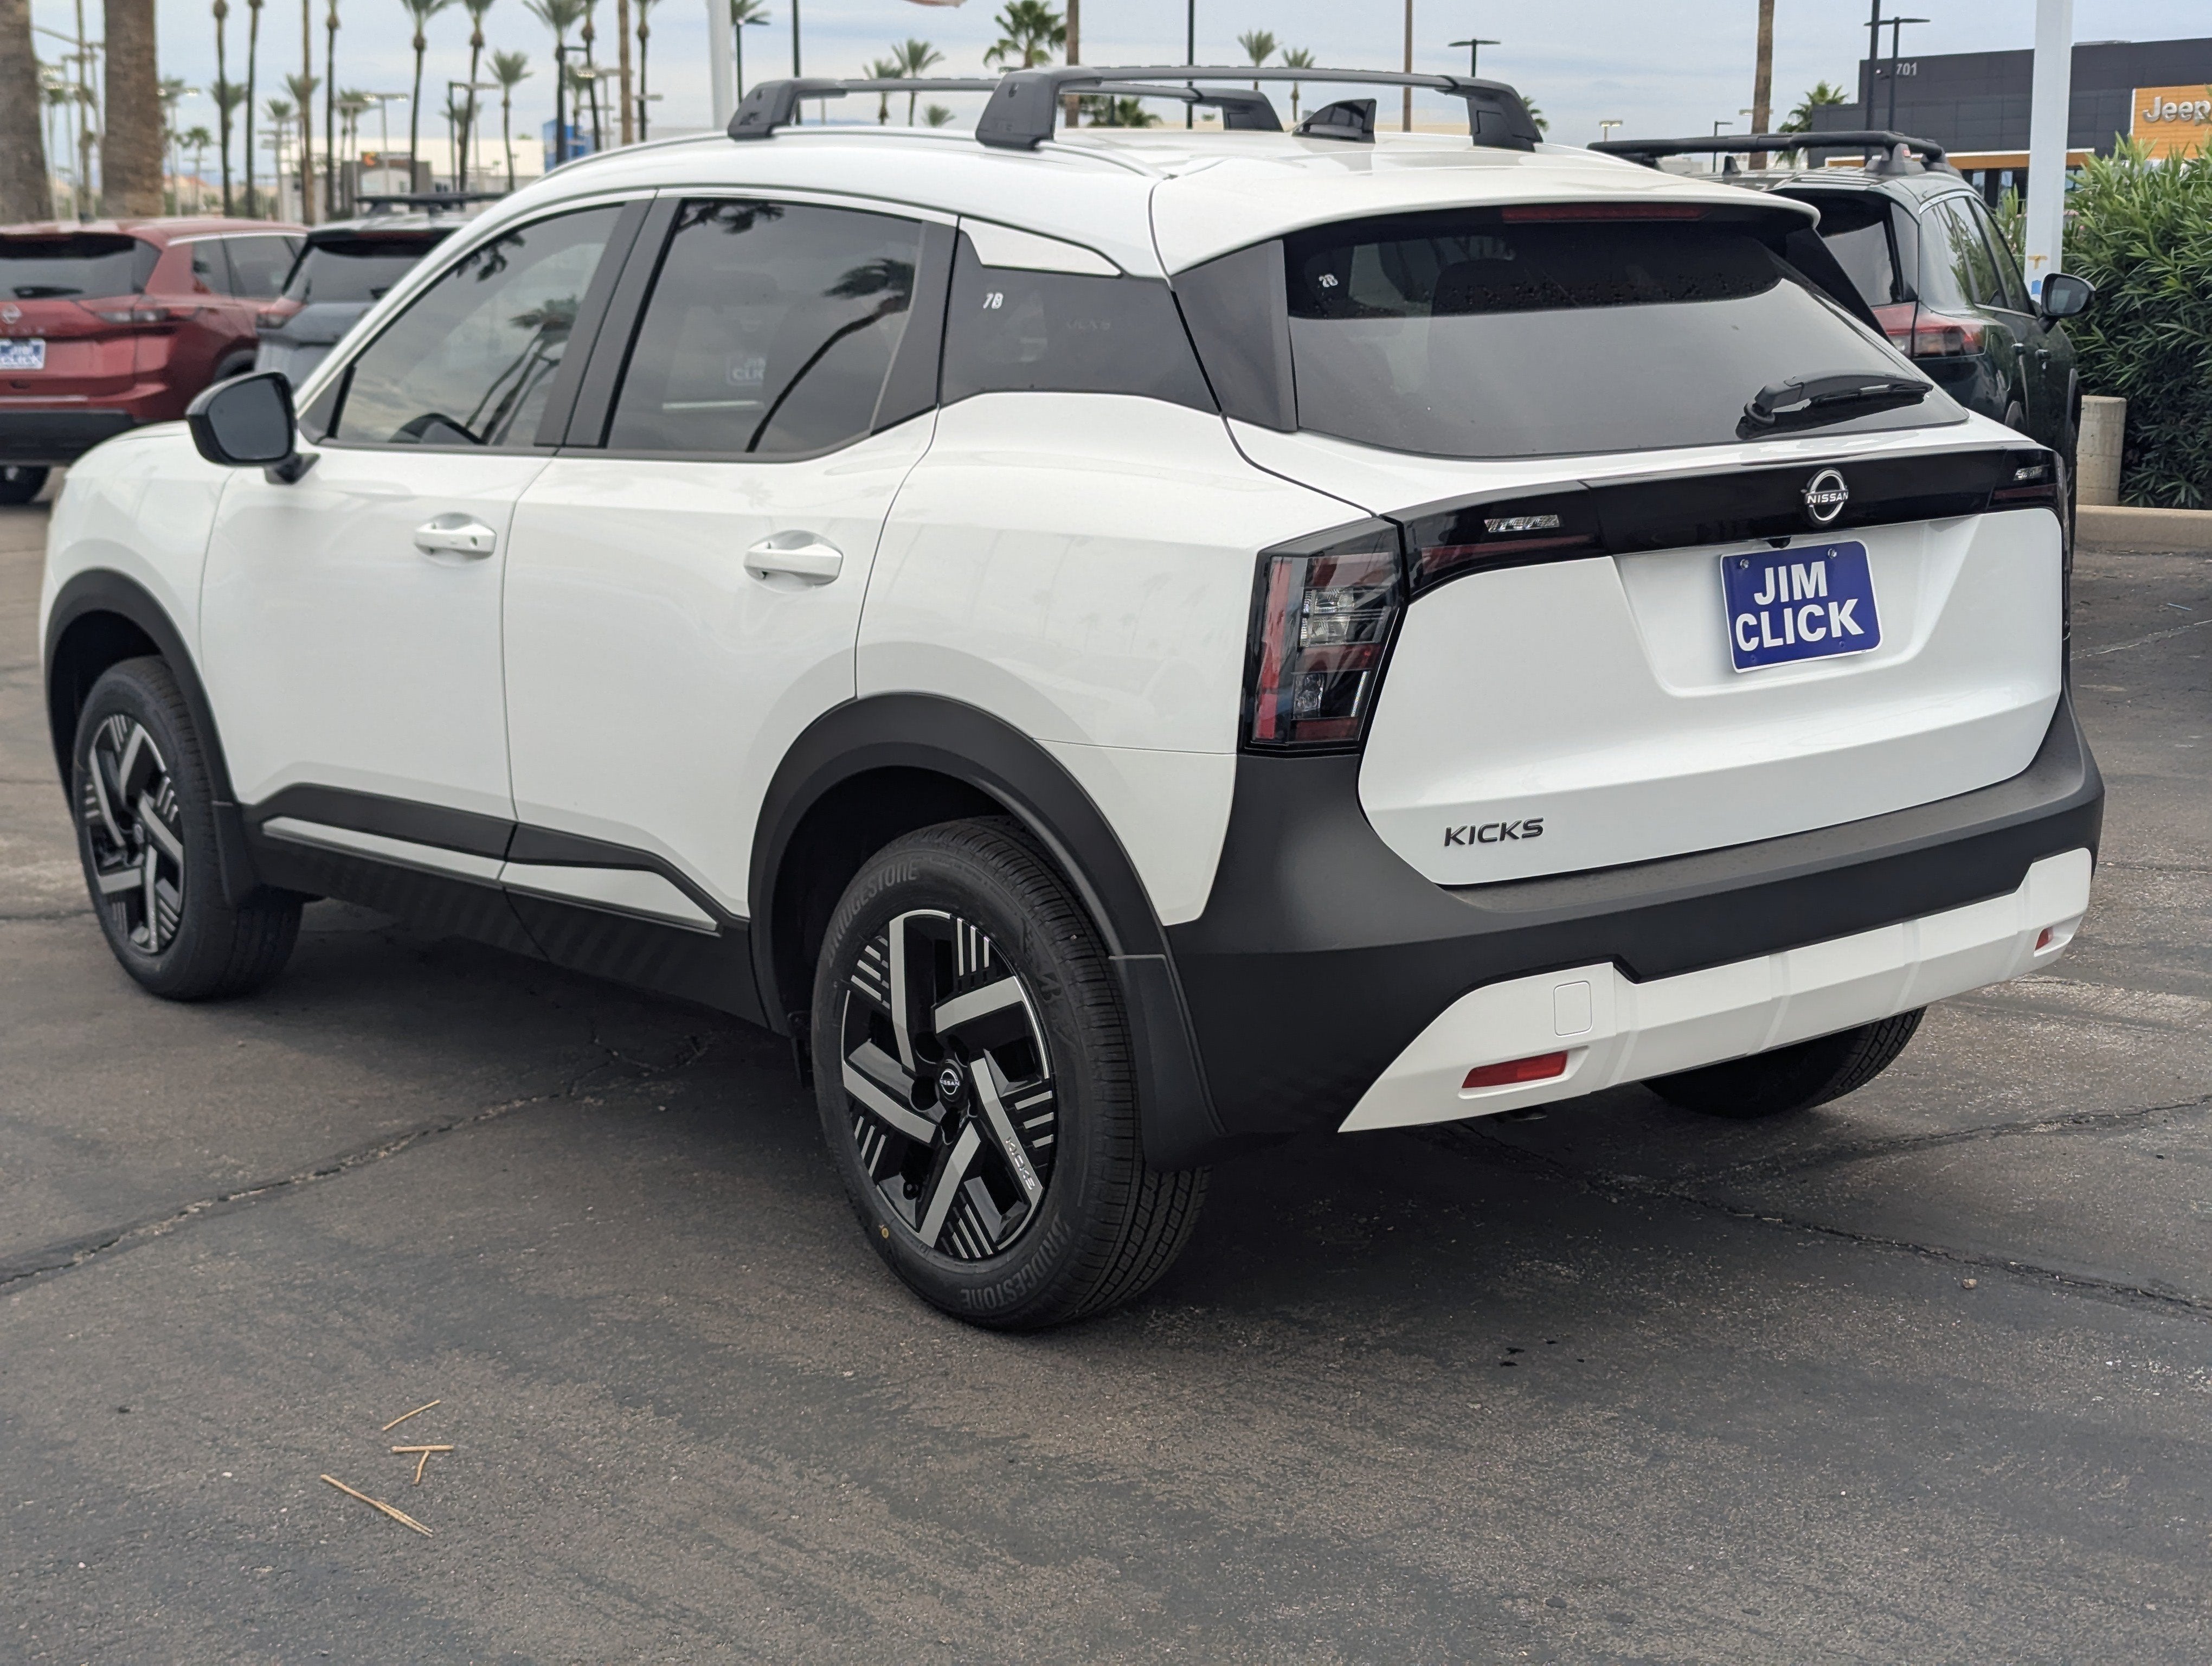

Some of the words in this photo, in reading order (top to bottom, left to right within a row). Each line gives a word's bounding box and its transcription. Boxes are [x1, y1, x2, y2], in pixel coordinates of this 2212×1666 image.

[2142, 96, 2211, 127] Jeep
[1807, 491, 1849, 503] NISSAN
[1753, 560, 1828, 606] JIM
[1735, 598, 1865, 651] CLICK
[1444, 817, 1545, 847] KICKS
